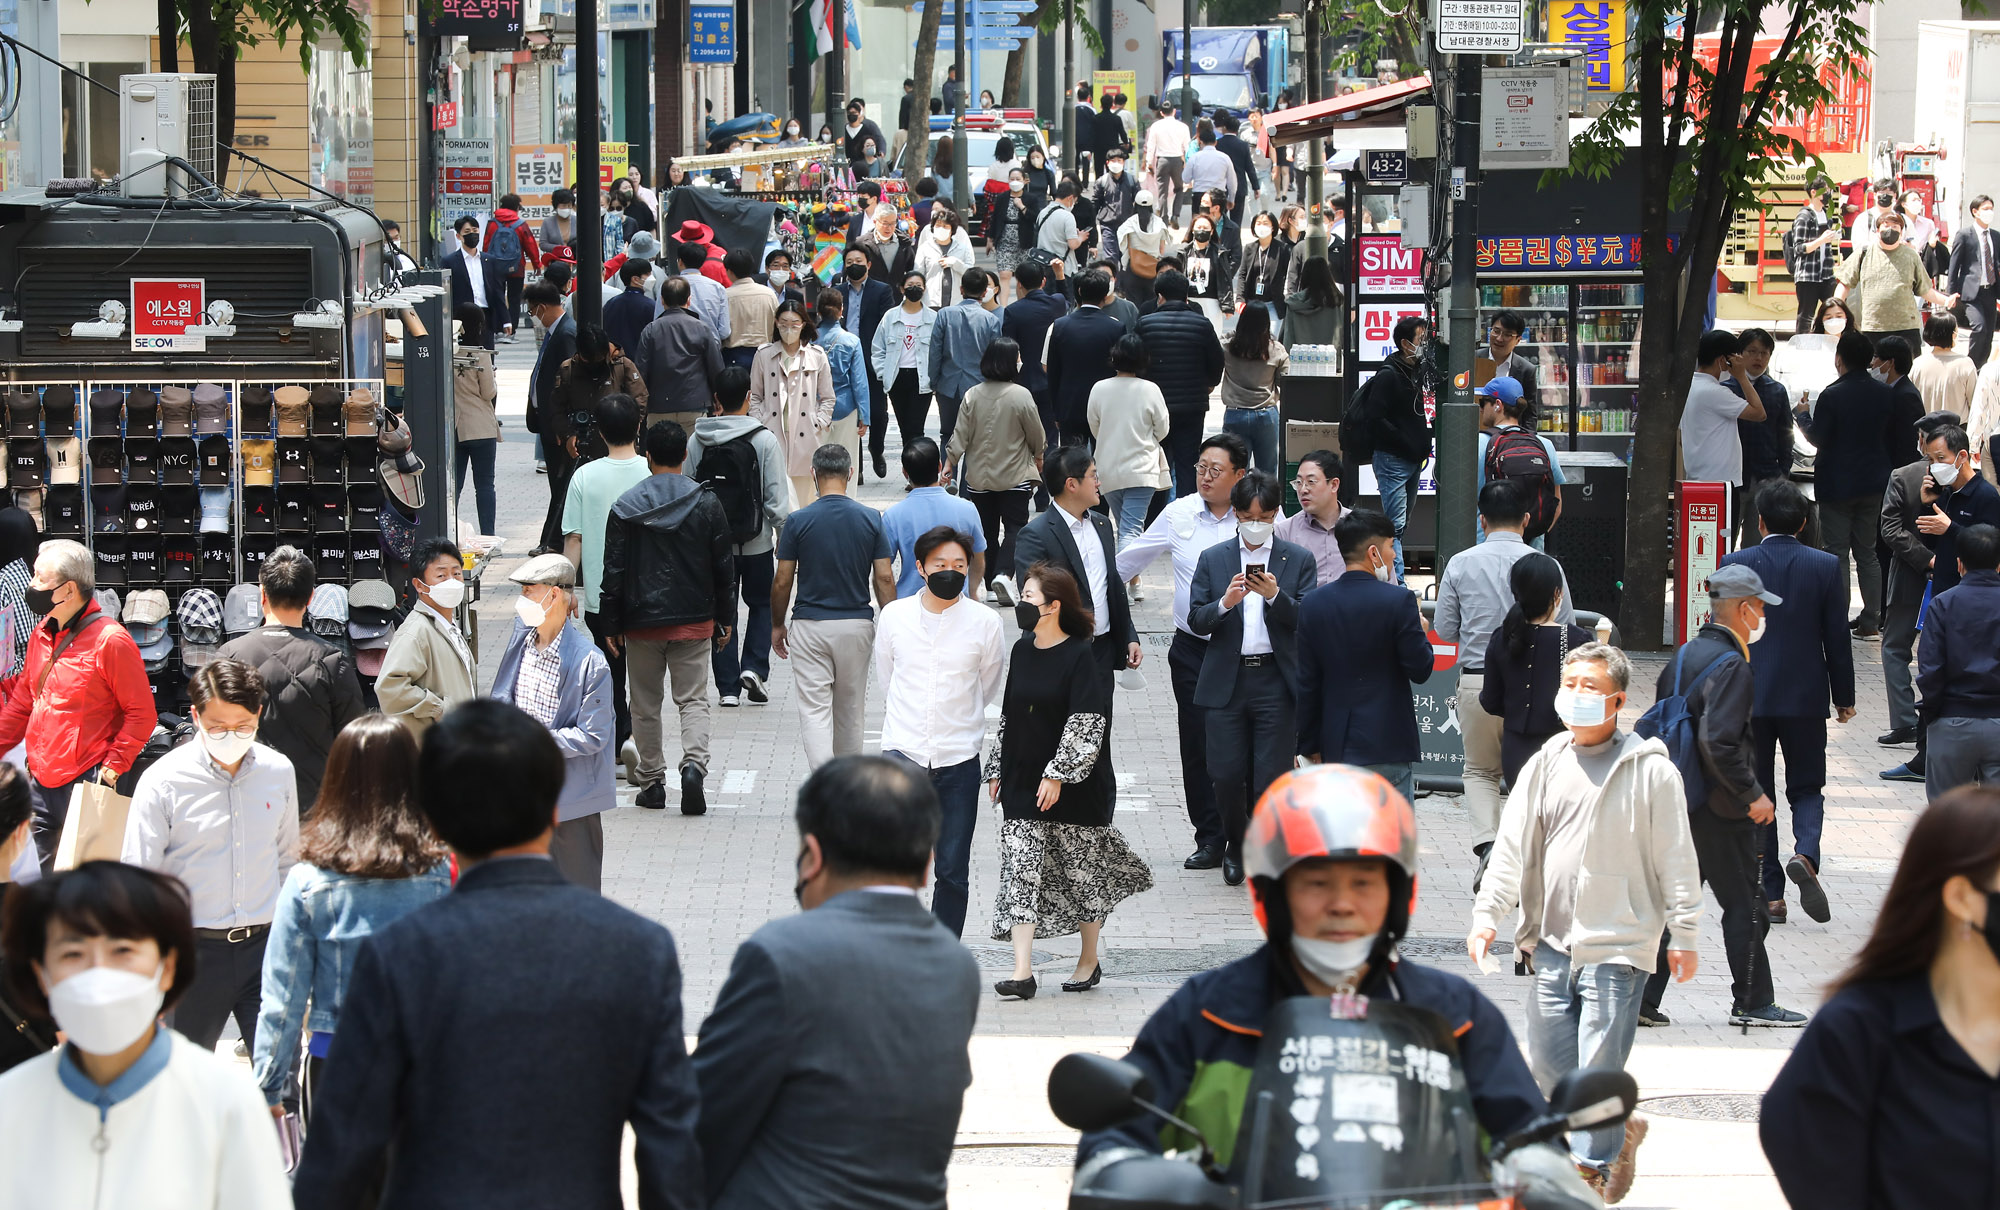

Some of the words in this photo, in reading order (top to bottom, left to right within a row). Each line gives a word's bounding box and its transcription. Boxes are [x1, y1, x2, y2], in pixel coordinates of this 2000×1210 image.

[1444, 3, 1458, 13] 구간
[1462, 4, 1502, 14] 명동관광특구
[1504, 4, 1518, 14] 일대
[507, 23, 519, 32] 5F
[1449, 36, 1510, 46] 남대문경찰서장
[1519, 80, 1538, 88] 작동중
[1371, 159, 1403, 172] 43-2
[517, 161, 563, 185] 부동산
[447, 197, 462, 206] THE
[463, 197, 487, 206] SAEM
[1362, 246, 1413, 271] SIM
[146, 300, 192, 317] 에스원
[135, 338, 172, 348] SECOM
[17, 457, 34, 465] BTS
[163, 454, 188, 465] NYC
[130, 502, 155, 512] KOREA
[1690, 506, 1716, 515] 사용법
